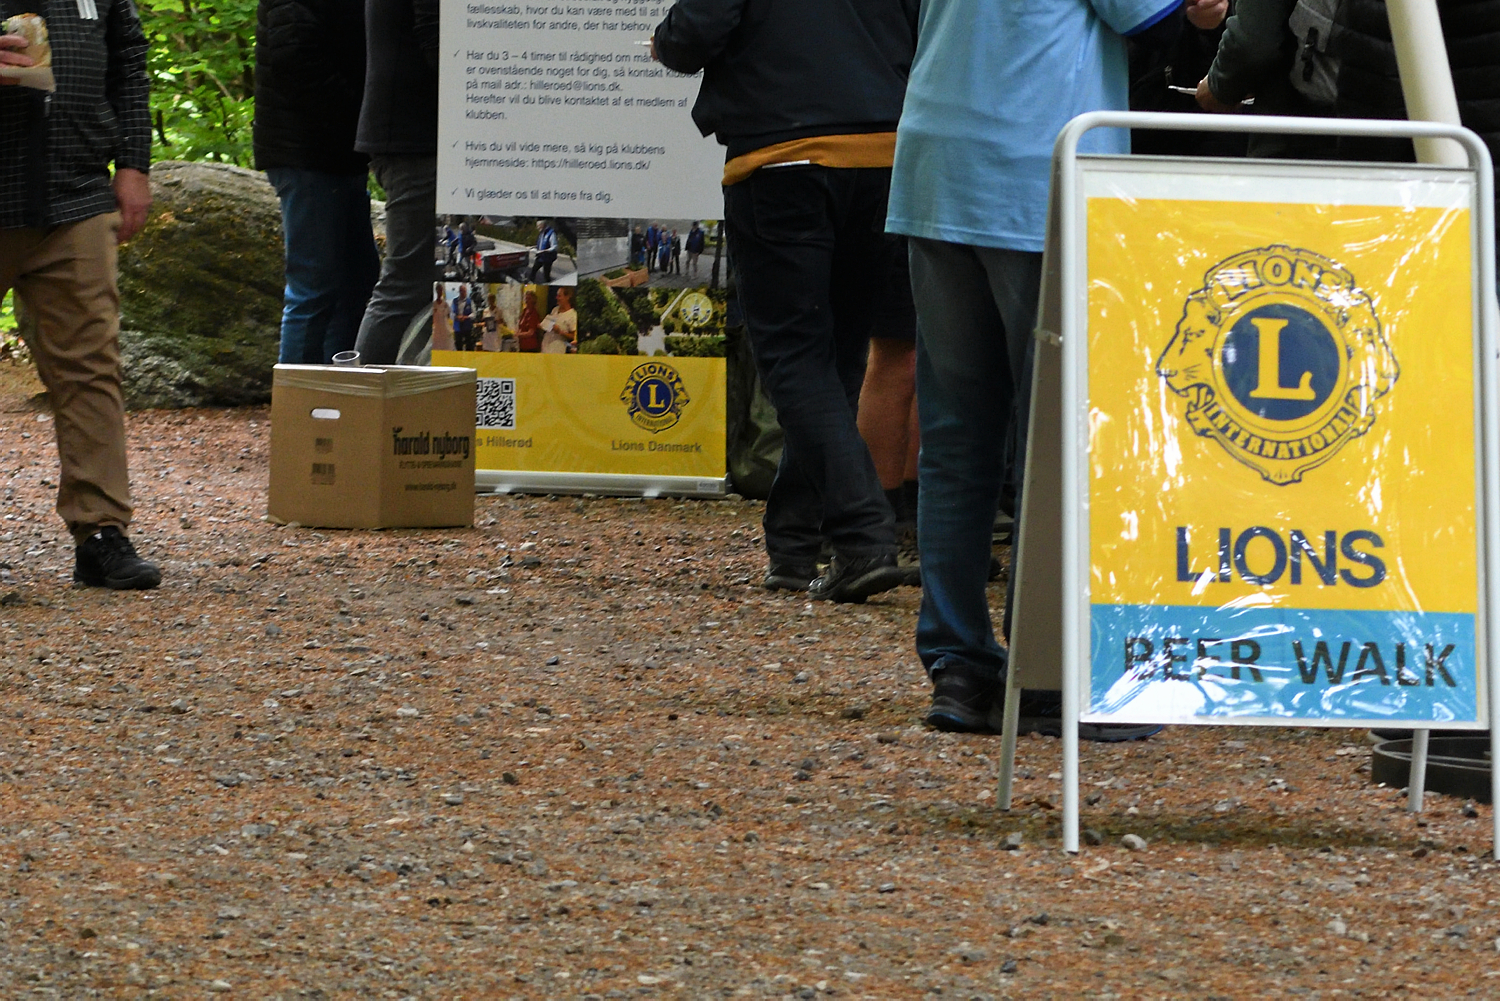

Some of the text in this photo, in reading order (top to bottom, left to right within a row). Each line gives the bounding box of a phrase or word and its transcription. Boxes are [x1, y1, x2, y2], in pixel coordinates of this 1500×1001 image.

[526, 4, 548, 17] hvor
[551, 4, 563, 17] du
[567, 4, 584, 17] kan
[588, 7, 612, 17] være
[616, 5, 636, 18] med
[639, 5, 647, 18] til
[650, 5, 658, 18] at
[467, 17, 530, 31] livskvaliteten
[533, 18, 546, 31] for
[584, 19, 599, 32] der
[603, 19, 618, 32] har
[467, 48, 484, 61] Har
[487, 49, 499, 61] du
[503, 49, 509, 62] 3
[522, 49, 527, 62] 4
[531, 49, 556, 62] timer
[559, 50, 567, 62] til
[570, 50, 612, 66] rådighed
[615, 53, 630, 63] om
[466, 66, 476, 76] er
[479, 64, 543, 77] ovenstående
[547, 64, 573, 80] noget
[577, 65, 589, 77] for
[614, 65, 625, 78] så
[628, 65, 662, 78] kontakt
[466, 78, 478, 94] på
[481, 79, 501, 91] mail
[466, 92, 687, 108] Herefter vil du blive kontaktet af et medlem af
[466, 139, 486, 152] Hvis
[490, 140, 502, 153] du
[506, 140, 516, 153] vil
[520, 140, 540, 153] vide
[574, 141, 586, 154] så
[589, 142, 603, 157] kig
[606, 142, 618, 158] på
[621, 142, 665, 155] klubbens
[465, 187, 474, 200] Vi
[477, 187, 512, 204] glæder
[516, 191, 527, 201] os
[531, 188, 539, 201] til
[542, 189, 551, 202] at
[554, 189, 577, 202] høre
[580, 190, 592, 202] fra
[1217, 254, 1345, 302] LIONS
[1249, 317, 1316, 400] L
[636, 364, 675, 381] LIONS
[648, 384, 665, 408] L
[1204, 402, 1357, 460] INTERNATIONAL
[432, 431, 470, 460] nyborg
[486, 435, 533, 448] Hillerød
[611, 440, 702, 453] Lions Danmark
[1177, 526, 1387, 588] LIONS
[1292, 639, 1457, 688] WALK
